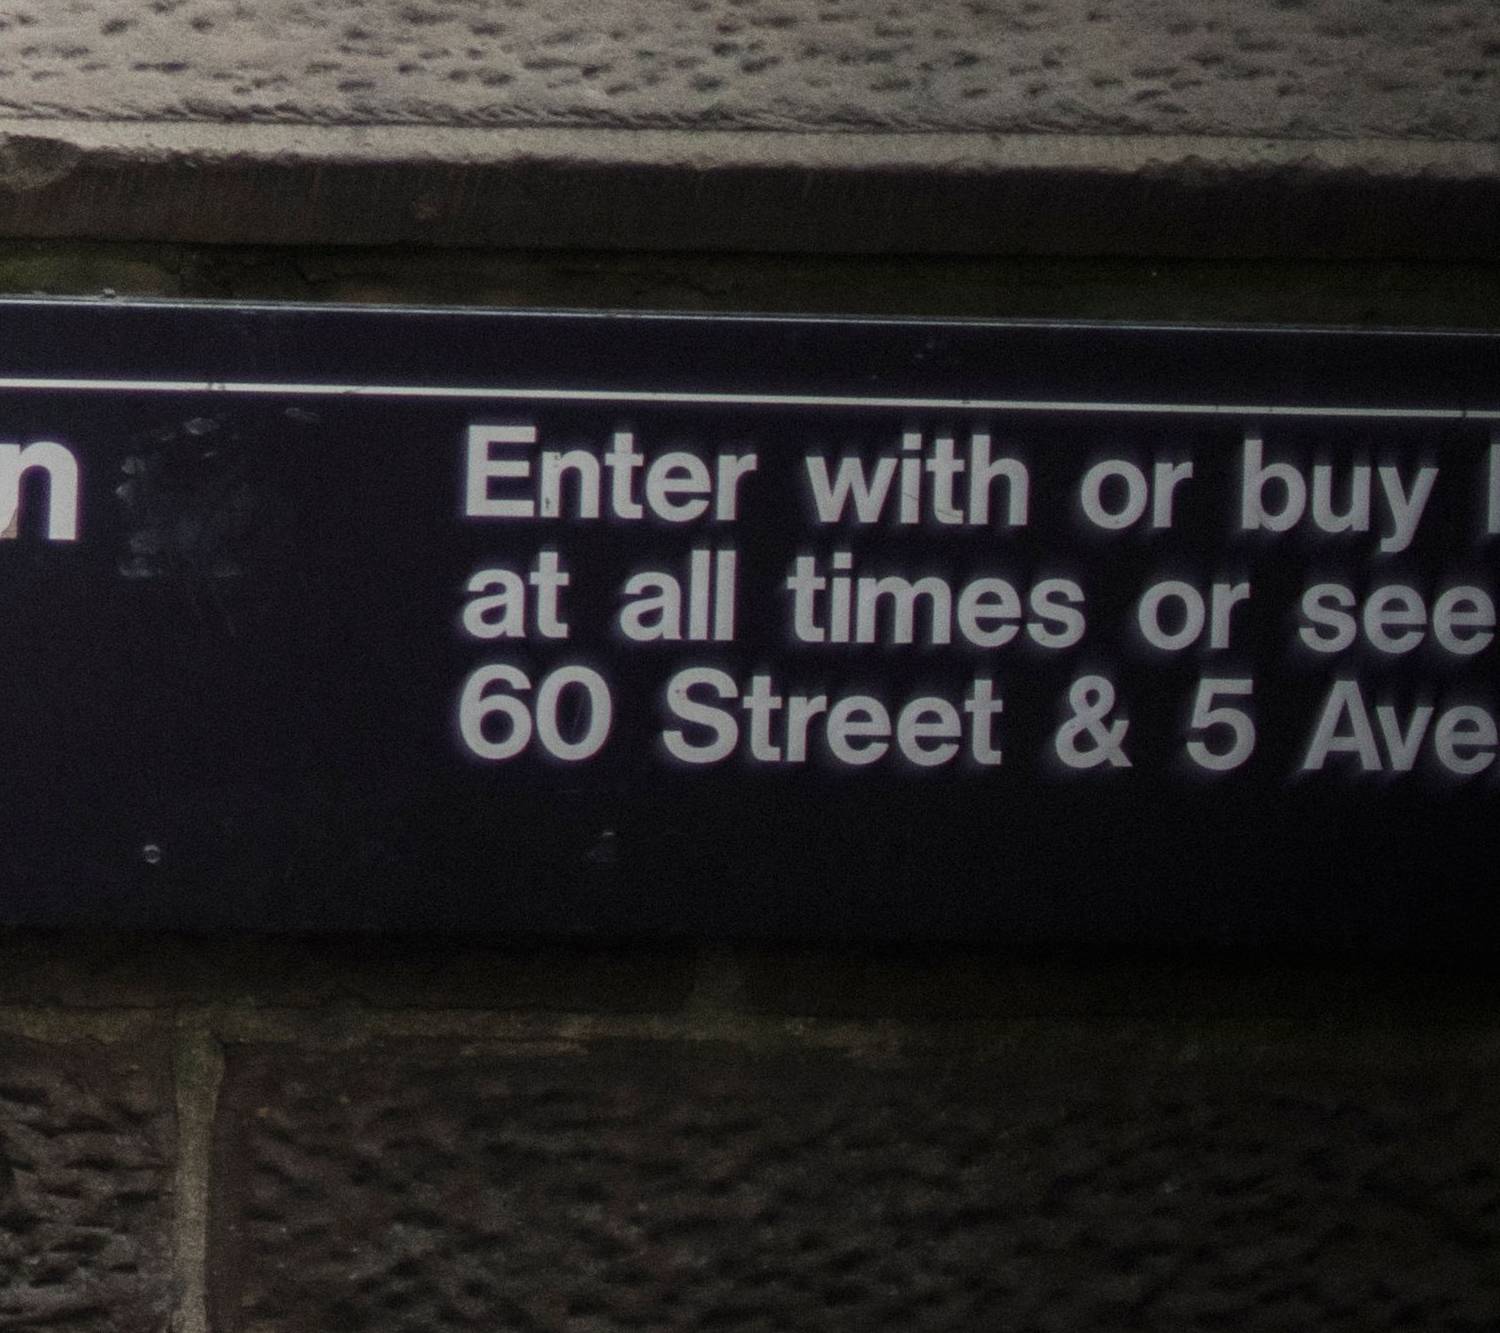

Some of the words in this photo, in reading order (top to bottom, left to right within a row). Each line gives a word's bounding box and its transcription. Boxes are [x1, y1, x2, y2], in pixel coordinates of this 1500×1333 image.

[465, 424, 757, 523] Enter
[805, 434, 1030, 526] with
[1080, 459, 1194, 530] or
[1241, 438, 1439, 553] buy
[461, 551, 570, 640] at
[618, 549, 737, 642] all
[786, 551, 1086, 649] times
[1137, 580, 1250, 650] or
[1299, 583, 1497, 655] see
[457, 663, 613, 761] 60
[661, 666, 1004, 766] Street
[1054, 675, 1132, 769] &
[1186, 678, 1255, 771] 5
[1302, 680, 1499, 775] Ave
